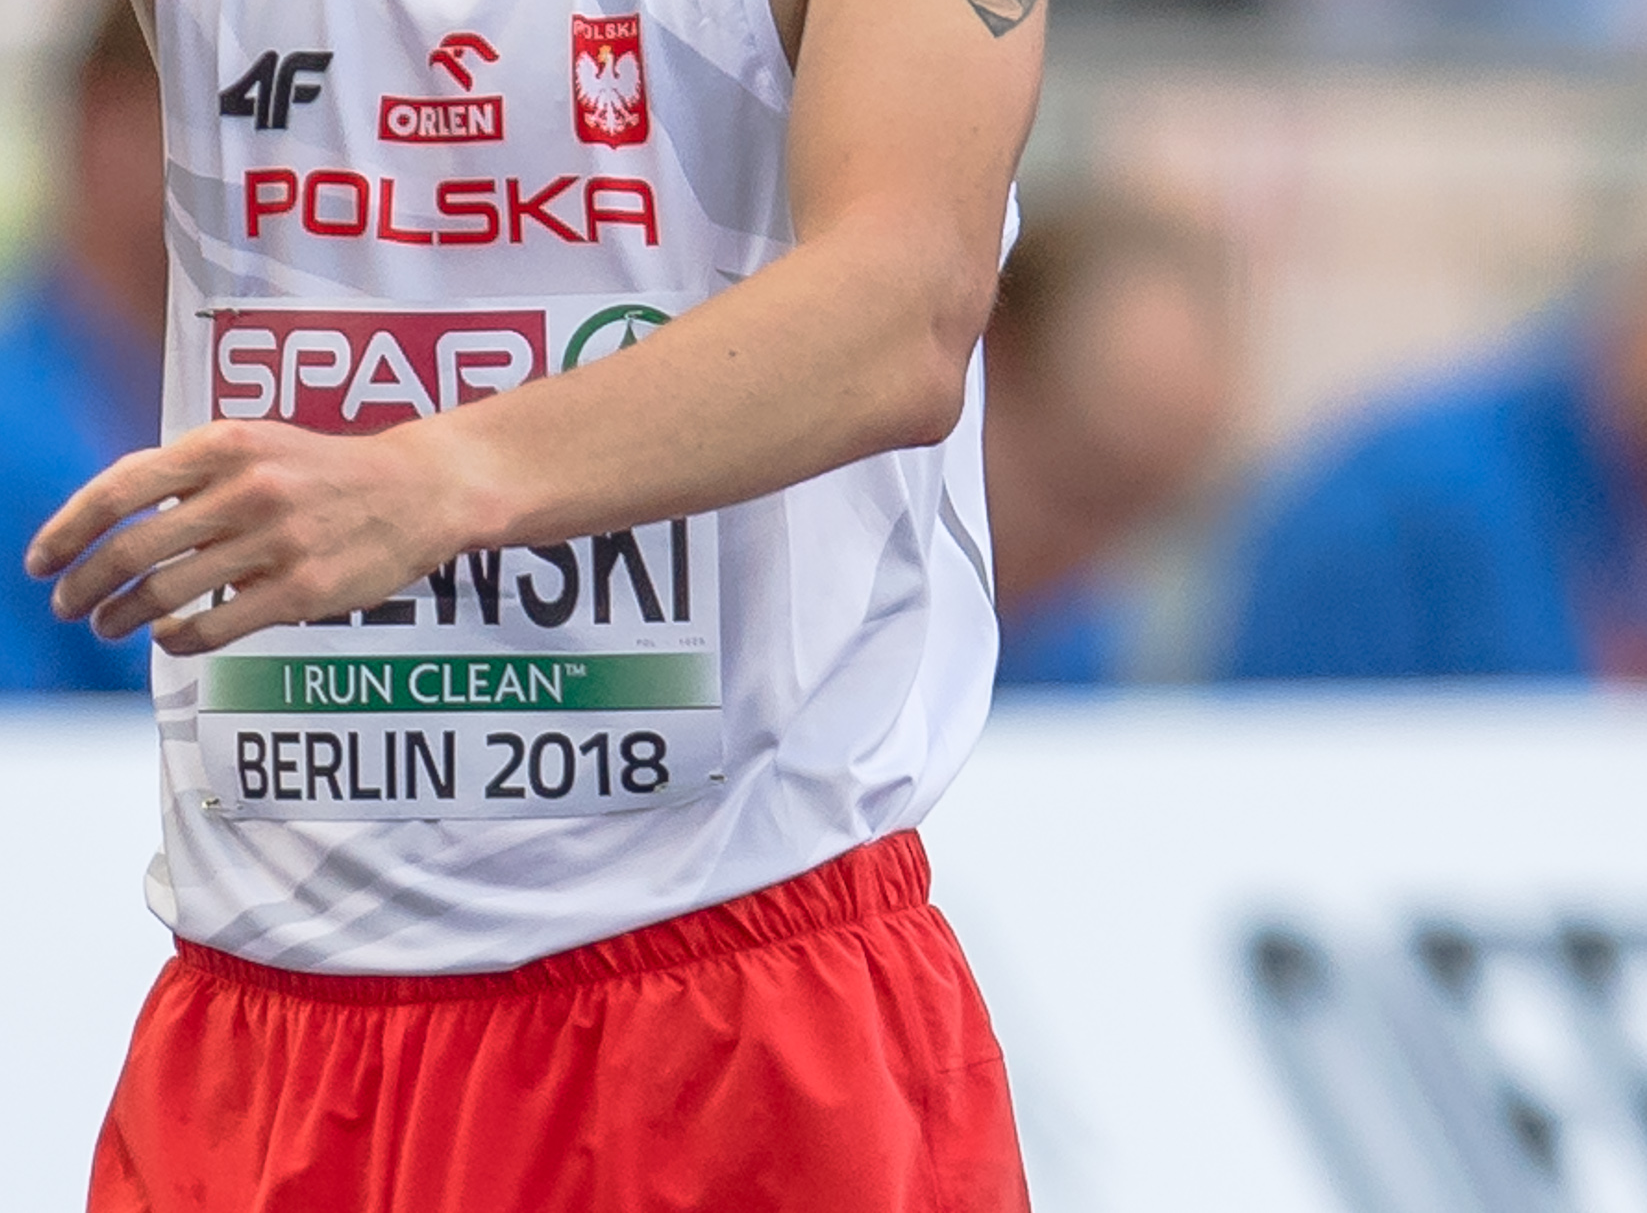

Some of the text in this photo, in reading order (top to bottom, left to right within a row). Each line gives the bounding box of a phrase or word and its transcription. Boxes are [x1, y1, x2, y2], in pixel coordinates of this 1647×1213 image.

[219, 50, 334, 129] 4F
[386, 103, 495, 137] ORLEN
[244, 169, 660, 246] POLSKA
[283, 664, 292, 704] I
[304, 663, 393, 704] RUN
[237, 730, 670, 801] BERLIN 2018
